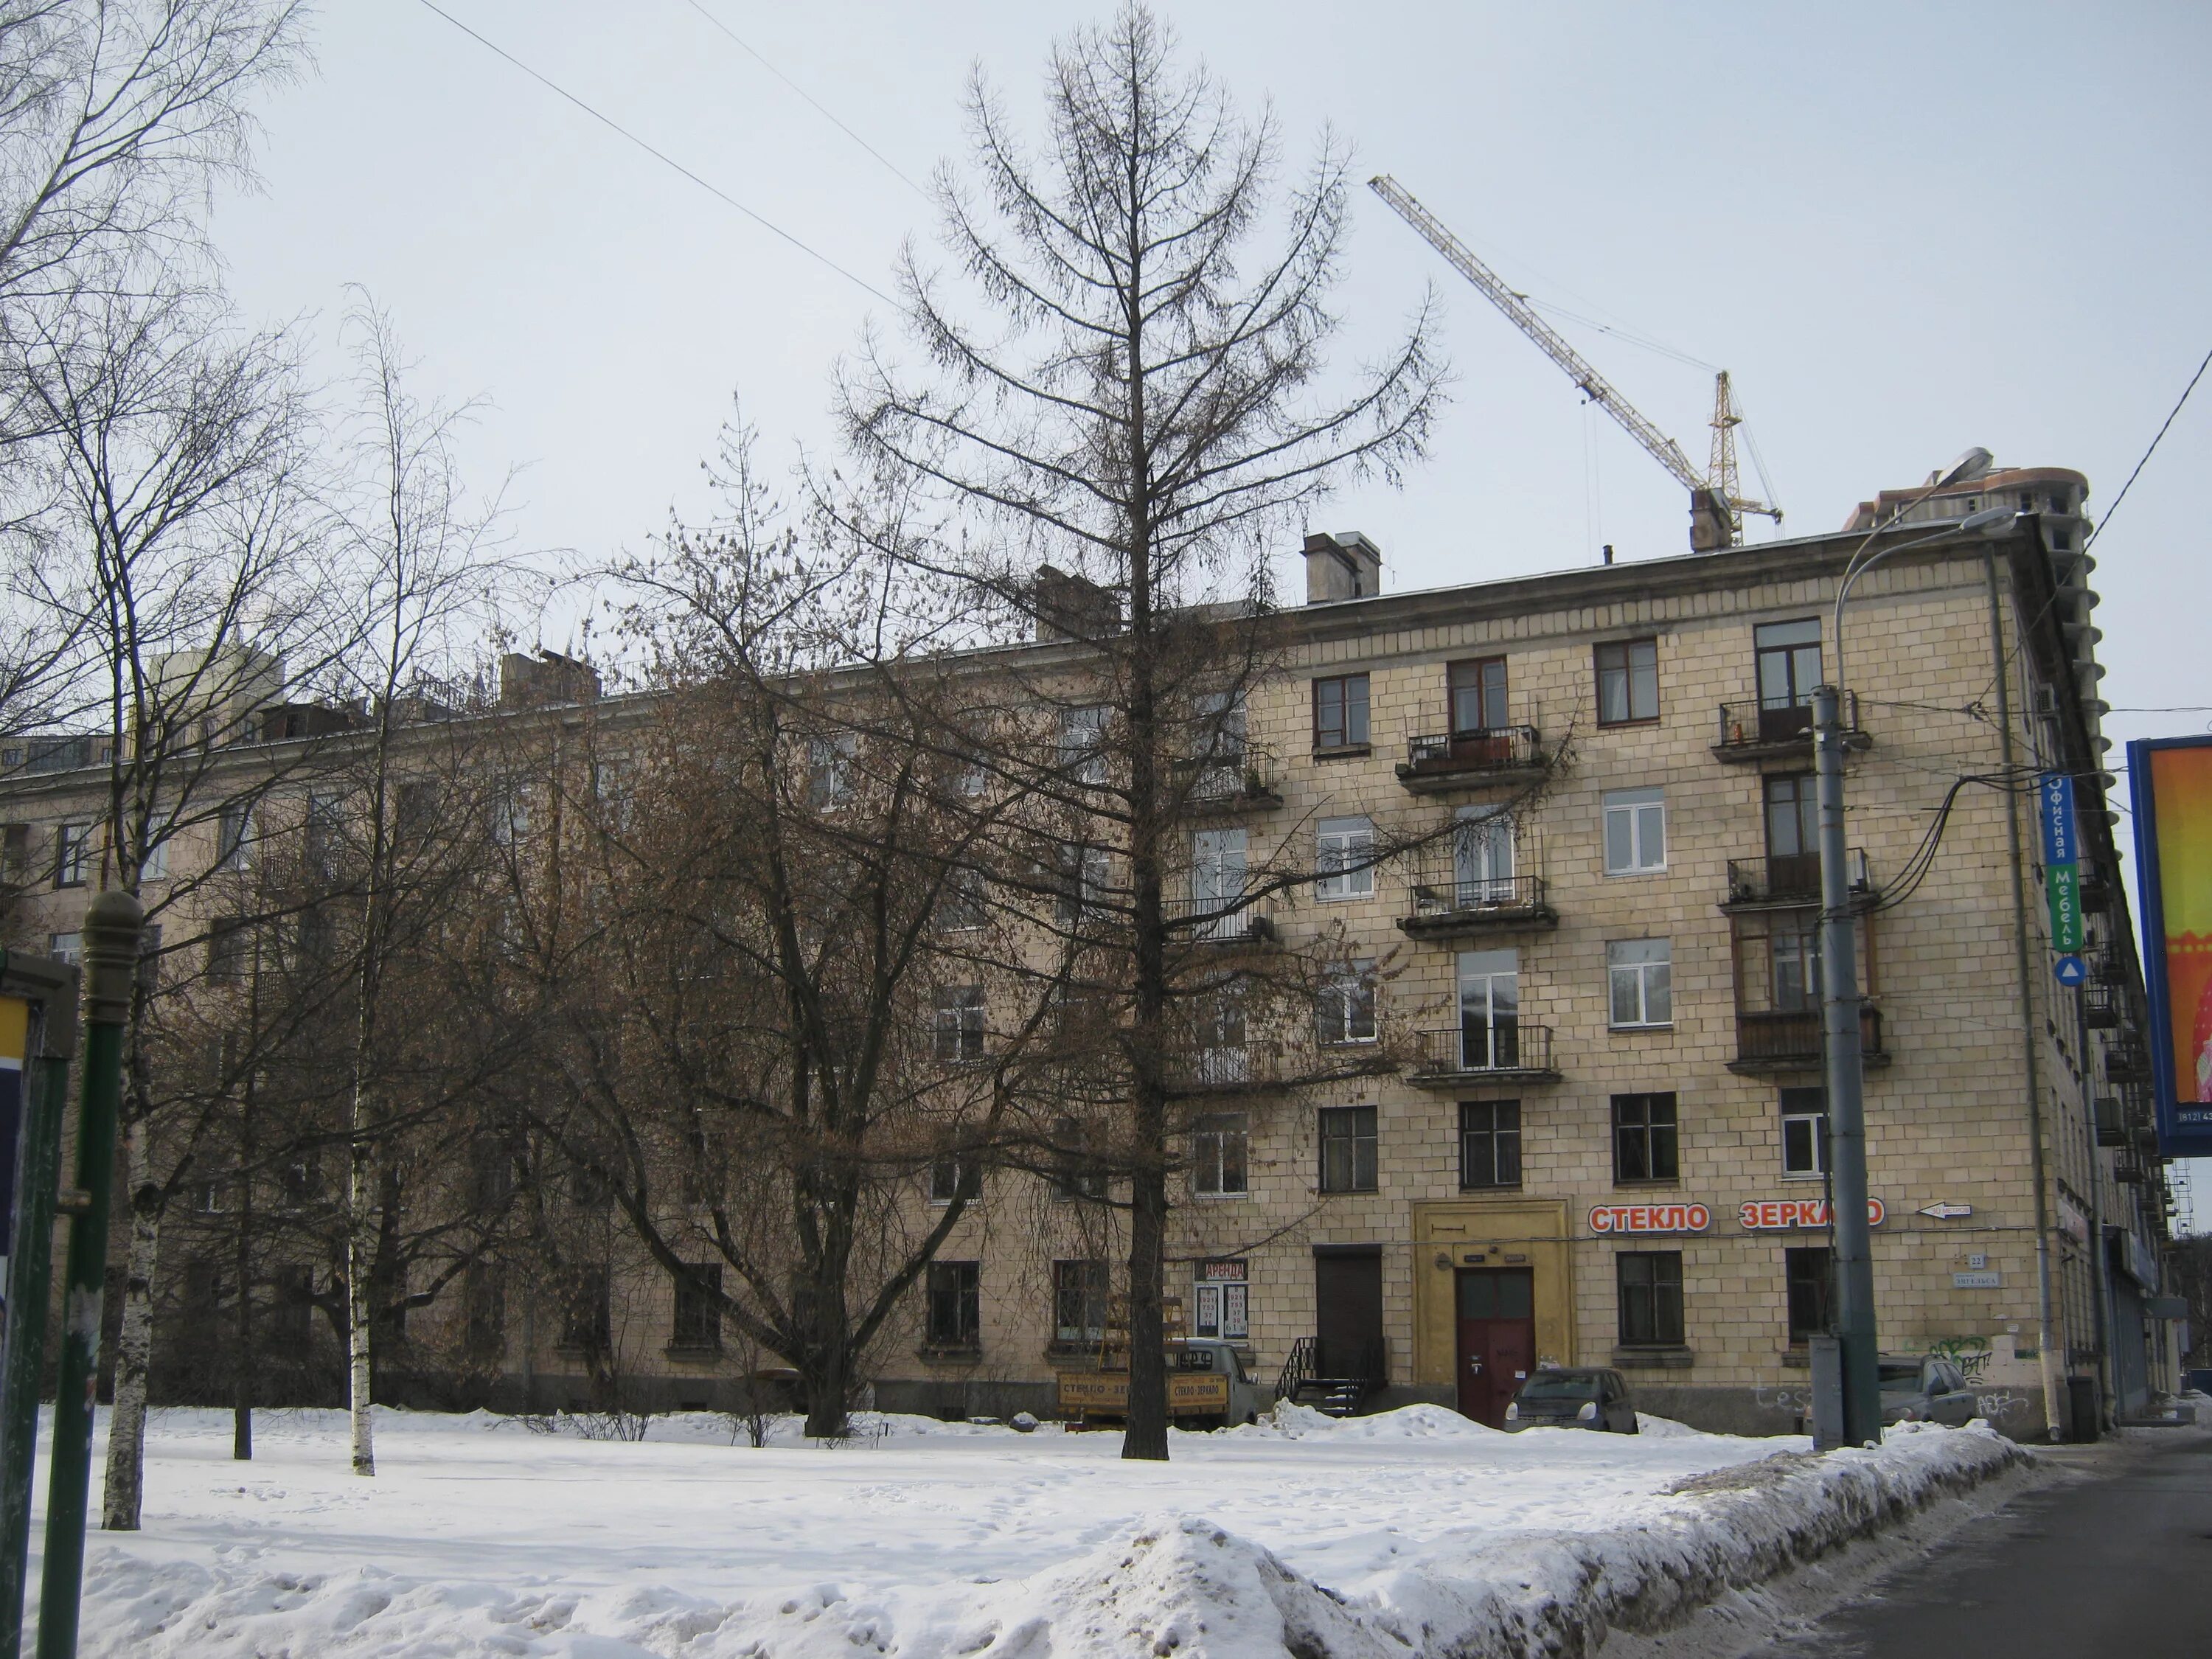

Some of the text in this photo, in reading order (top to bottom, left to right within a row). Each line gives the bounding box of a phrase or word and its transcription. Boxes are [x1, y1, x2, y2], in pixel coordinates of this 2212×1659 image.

[2048, 778, 2065, 858] Офисная
[2055, 870, 2071, 945] Мебель
[2179, 1112, 2200, 1121] (812)
[1590, 1205, 1708, 1231] СТЕКЛО
[1742, 1200, 1882, 1227] ЗЕРКАО
[1931, 1207, 1941, 1215] 30
[1206, 1263, 1244, 1280] АРЕНДА
[1175, 1386, 1194, 1396] СТЕКЛО
